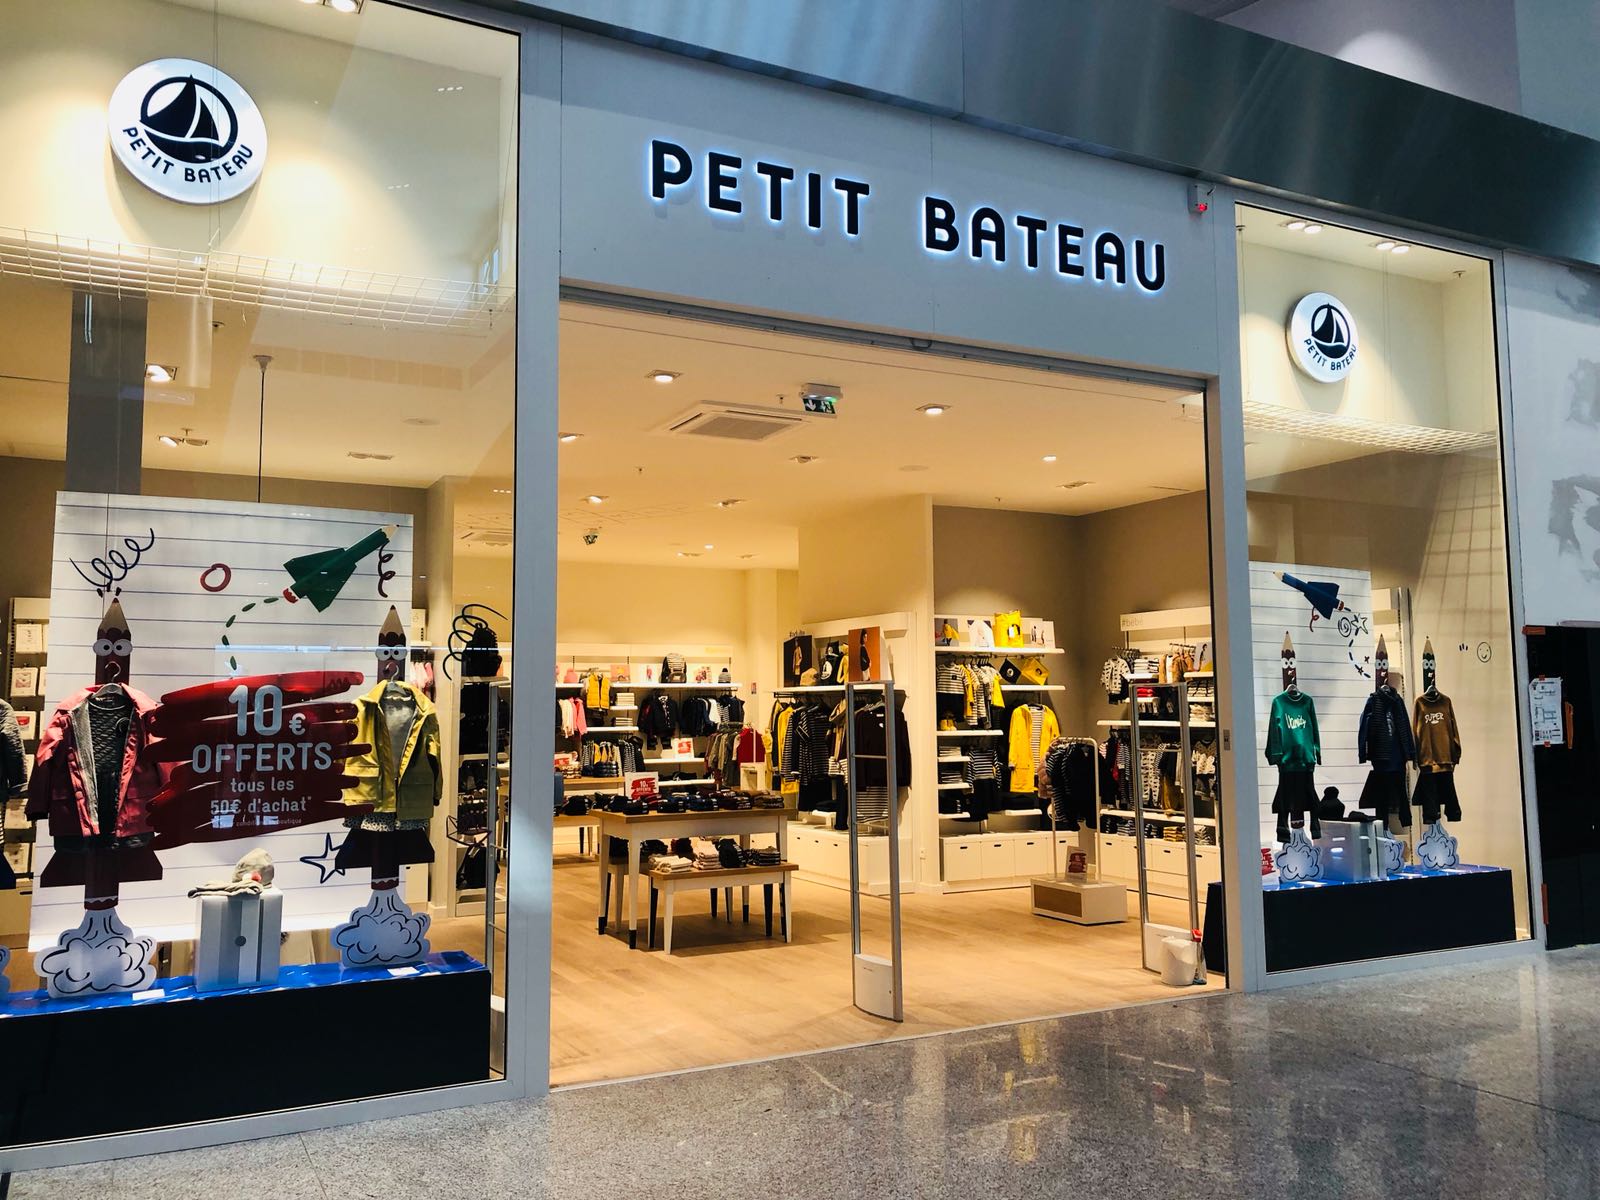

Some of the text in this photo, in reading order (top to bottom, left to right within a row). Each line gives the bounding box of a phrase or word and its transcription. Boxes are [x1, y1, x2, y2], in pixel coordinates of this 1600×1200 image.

[122, 127, 253, 183] PETIT BATEAU
[651, 139, 1165, 291] PETIT BATEAU
[1304, 338, 1357, 371] PETIT BATEAU
[192, 742, 332, 774] OFFERTS
[230, 776, 294, 792] tous les
[210, 799, 242, 815] 50€
